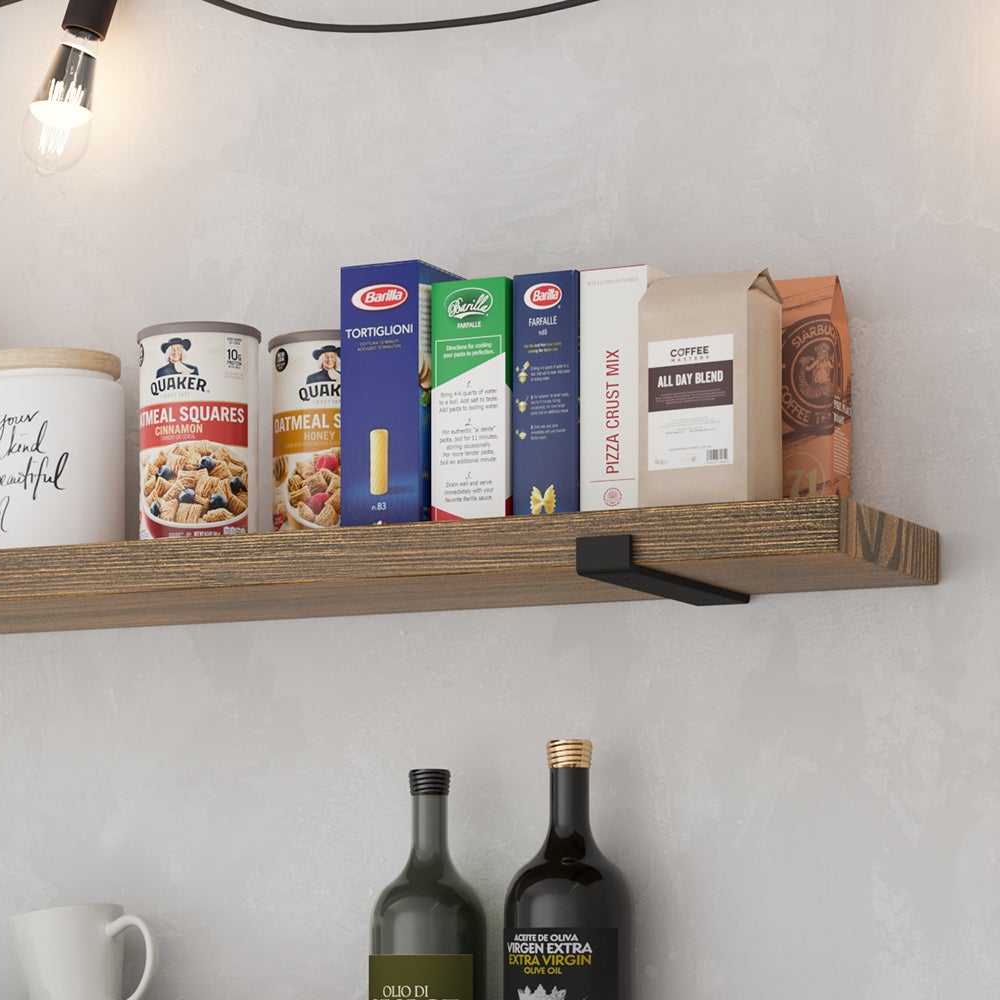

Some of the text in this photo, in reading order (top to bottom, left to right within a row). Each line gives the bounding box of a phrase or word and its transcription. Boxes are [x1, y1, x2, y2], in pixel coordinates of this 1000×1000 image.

[364, 289, 403, 304] Barilla
[533, 288, 559, 302] Barilla
[447, 293, 489, 317] Barilla
[457, 321, 481, 329] FARFALLE
[528, 315, 558, 327] FARFALLE
[345, 323, 413, 339] TORTIGLIONI
[791, 323, 839, 349] STARBUC
[670, 345, 709, 358] COFFEE
[670, 355, 709, 363] MASTERS
[150, 376, 207, 396] QUAKER
[657, 370, 724, 388] ALL DAY BLEND
[298, 384, 341, 401] QUAK
[179, 405, 245, 424] SQUARES
[605, 348, 620, 474] PIZZA CRUST MIX
[155, 423, 203, 437] CINNAMON
[274, 413, 330, 433] OATMEAL
[0, 420, 49, 460] kind
[303, 431, 336, 441] HONEY
[371, 501, 387, 511] n.83
[513, 933, 579, 942] ACEITE DE OLIVA
[507, 942, 593, 954] VIRGEN EXTRA
[508, 954, 592, 966] EXTRA VIRGIN
[523, 966, 563, 975] OLIVE OIL
[382, 985, 429, 998] OLIO DI
